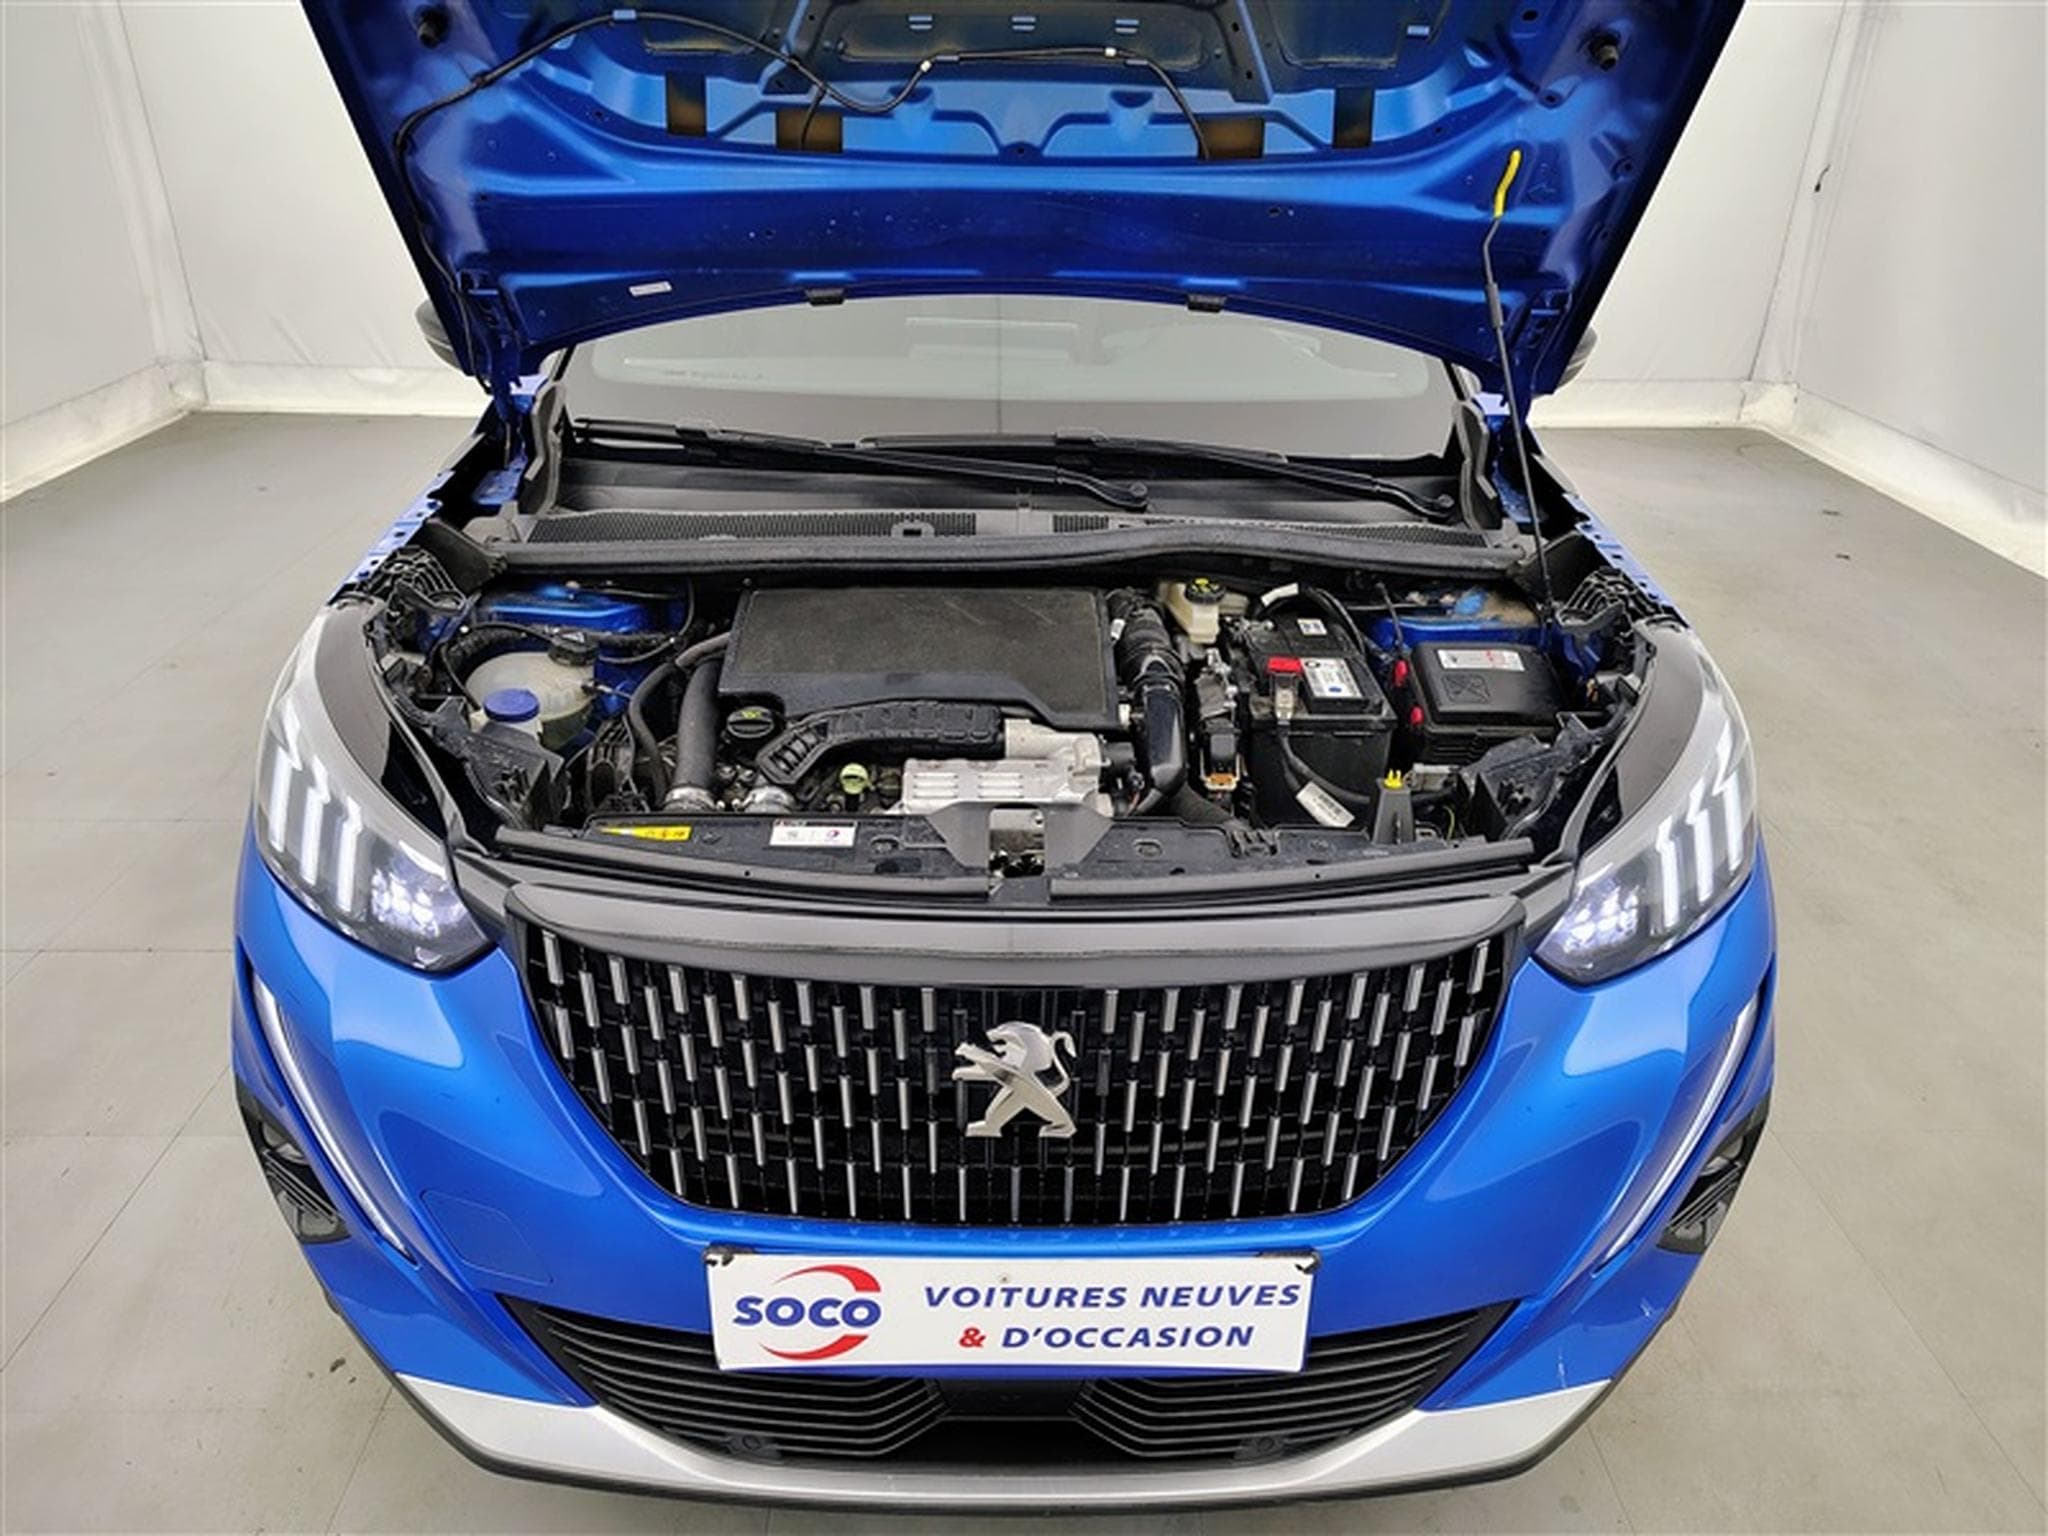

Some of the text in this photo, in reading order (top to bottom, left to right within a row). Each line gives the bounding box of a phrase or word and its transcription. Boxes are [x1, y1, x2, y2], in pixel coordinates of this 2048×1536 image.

[925, 1284, 1300, 1308] VOITURES NEUVES
[733, 1295, 882, 1329] SOCO
[958, 1326, 1254, 1348] & D'OCCASION
